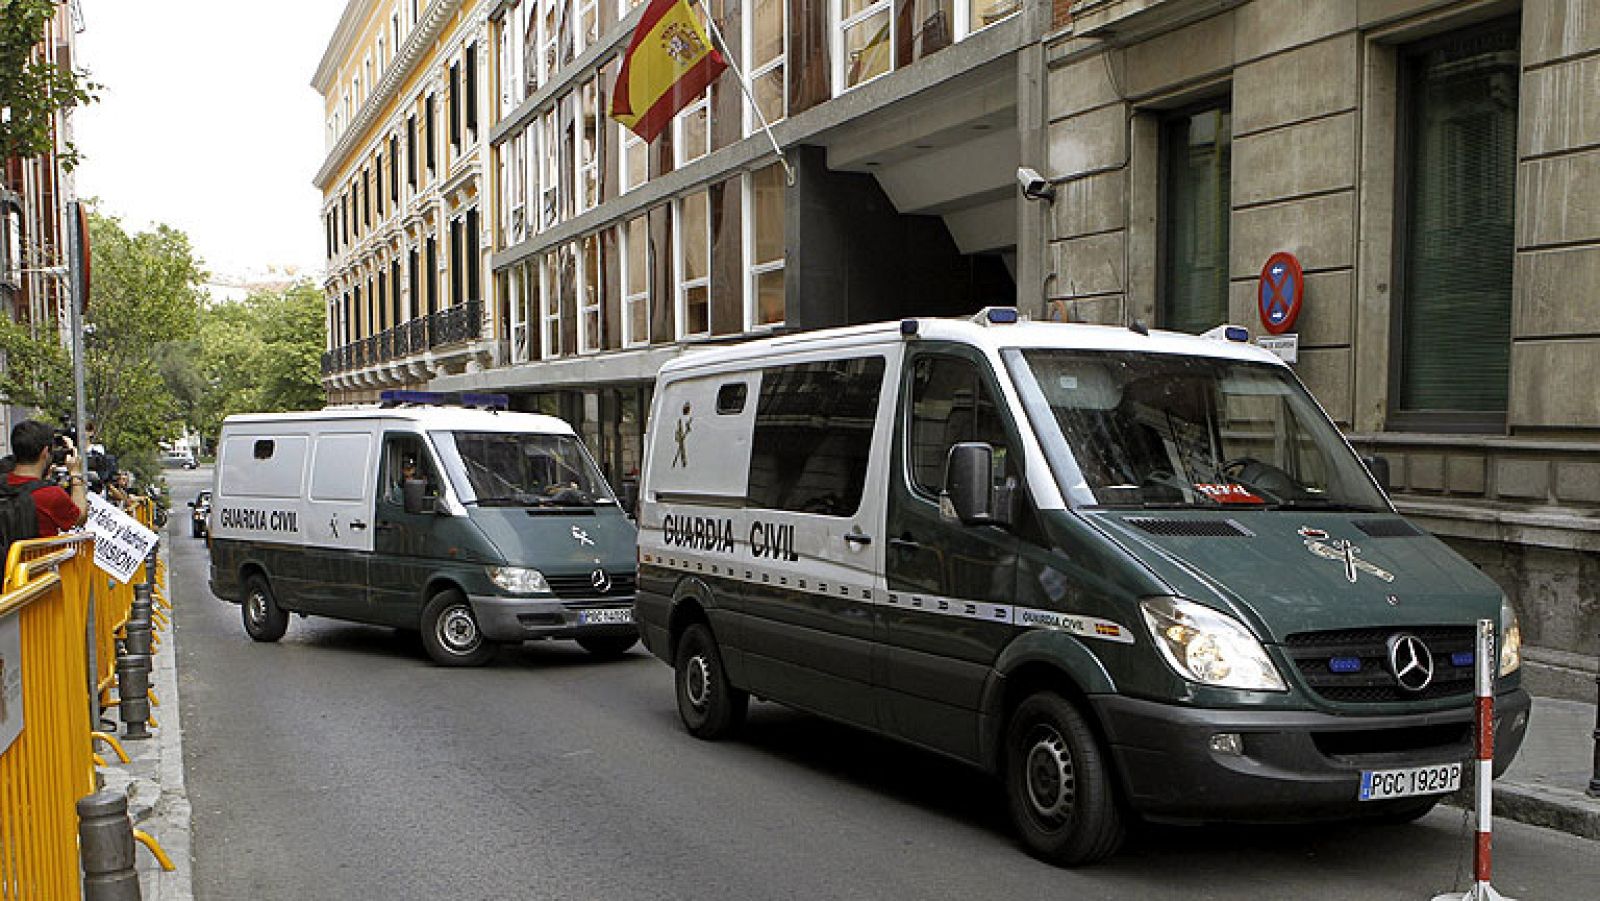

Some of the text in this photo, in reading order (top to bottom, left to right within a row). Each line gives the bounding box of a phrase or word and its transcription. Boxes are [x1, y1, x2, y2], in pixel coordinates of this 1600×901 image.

[220, 508, 299, 533] GUARDIA CIVIL
[664, 514, 799, 562] GUARDIA CIVIL
[1023, 611, 1084, 630] GUARDIA CIVIL
[1371, 766, 1459, 795] PGC 1929P
